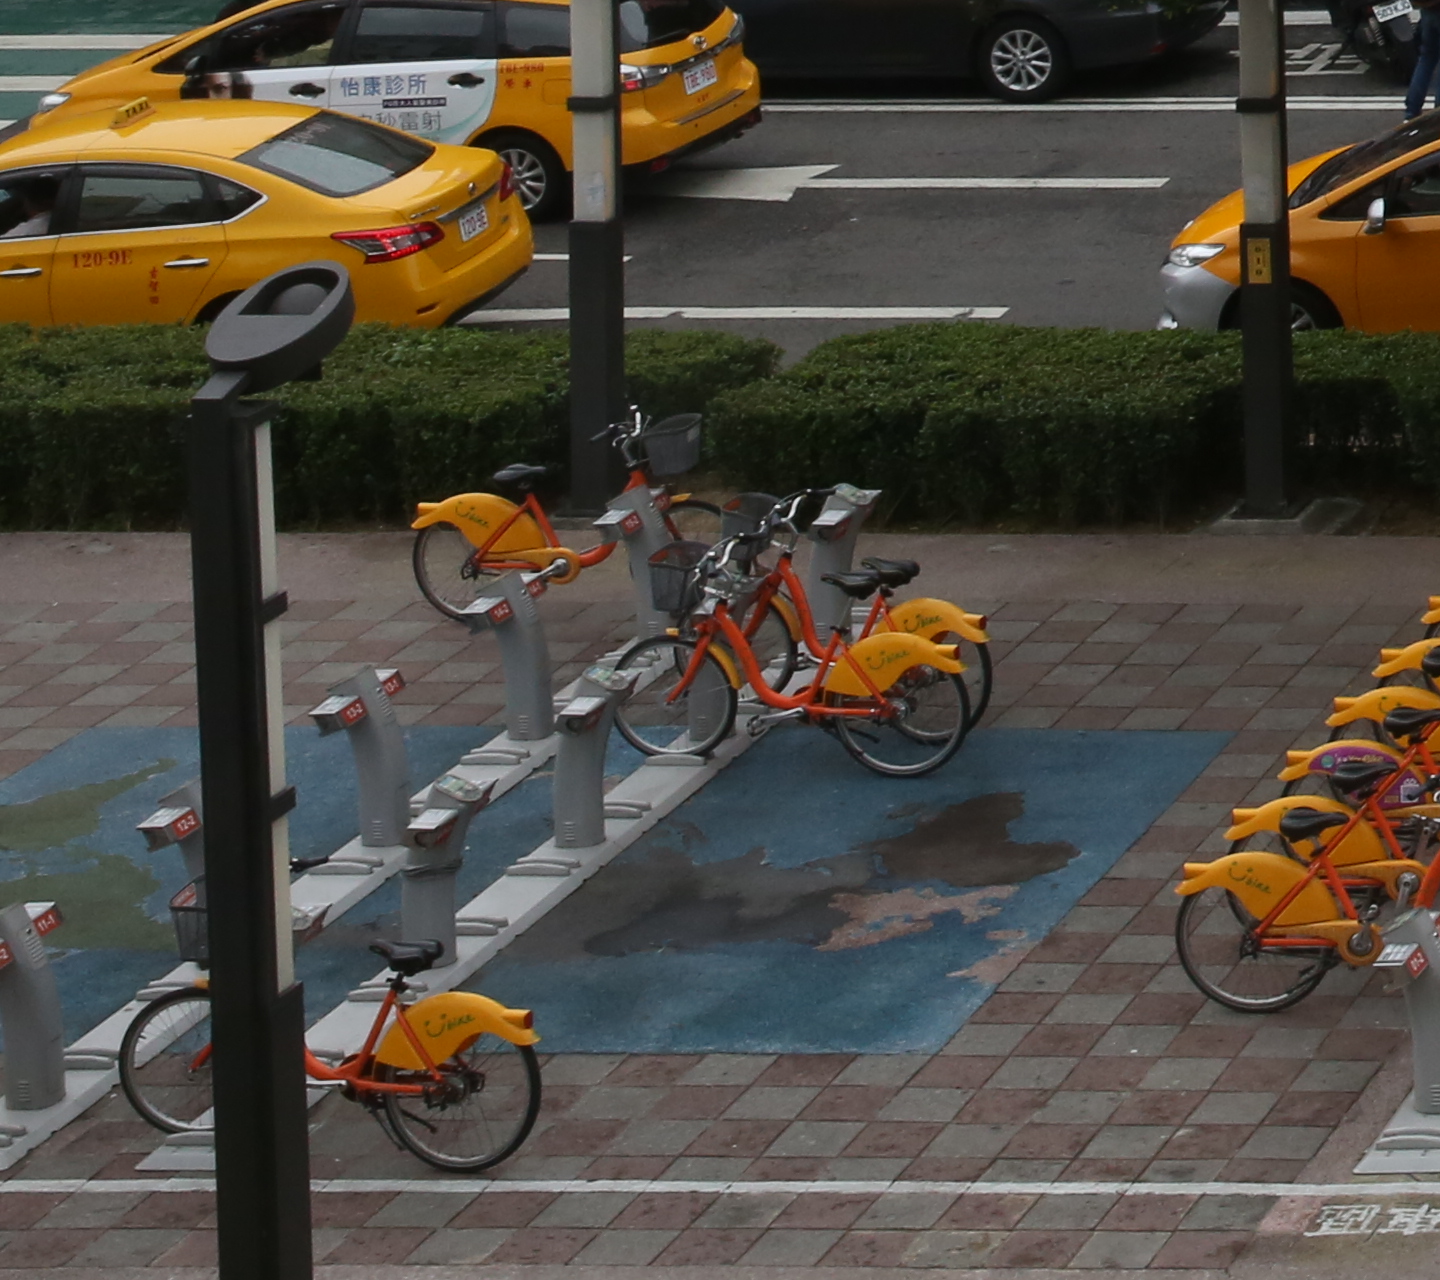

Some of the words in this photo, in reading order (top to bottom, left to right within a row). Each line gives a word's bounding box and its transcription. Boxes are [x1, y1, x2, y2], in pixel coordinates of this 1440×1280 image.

[340, 73, 428, 97] 怡康診所
[125, 100, 150, 118] TAXI
[361, 110, 442, 131] 秒雷射
[72, 249, 133, 269] 120-9E
